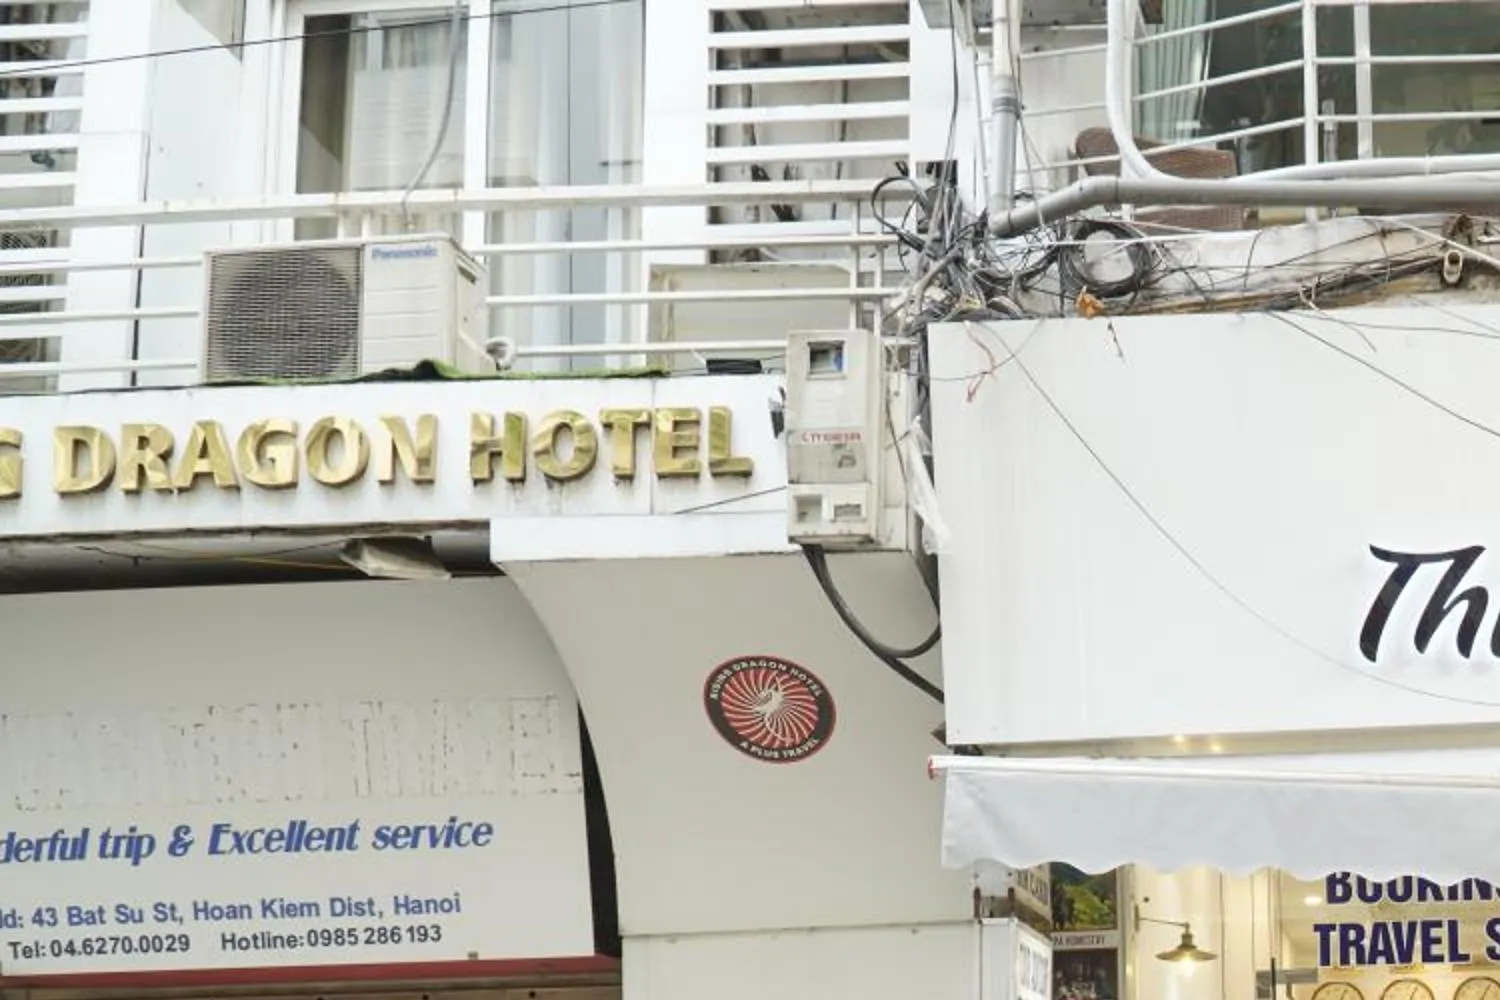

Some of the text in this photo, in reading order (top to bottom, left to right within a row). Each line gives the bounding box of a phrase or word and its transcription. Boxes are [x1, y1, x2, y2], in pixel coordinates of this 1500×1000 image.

[54, 413, 439, 496] DRAGON
[470, 405, 754, 484] HOTEL
[733, 659, 788, 672] DRAGON
[790, 668, 824, 697] HOTEL
[98, 826, 156, 866] trip
[168, 825, 195, 857] &
[208, 819, 360, 856] Excellent
[371, 816, 494, 850] service
[31, 907, 58, 928] 43
[67, 905, 107, 926] Bat
[115, 904, 143, 924] Su
[153, 902, 184, 924] St,
[193, 900, 252, 921] Hoan
[261, 898, 321, 919] Kiem
[330, 896, 385, 919] Dist,
[393, 892, 462, 915] Hanoi
[364, 926, 401, 944] 286
[406, 924, 442, 942] 193
[1313, 920, 1470, 966] TRAVEL
